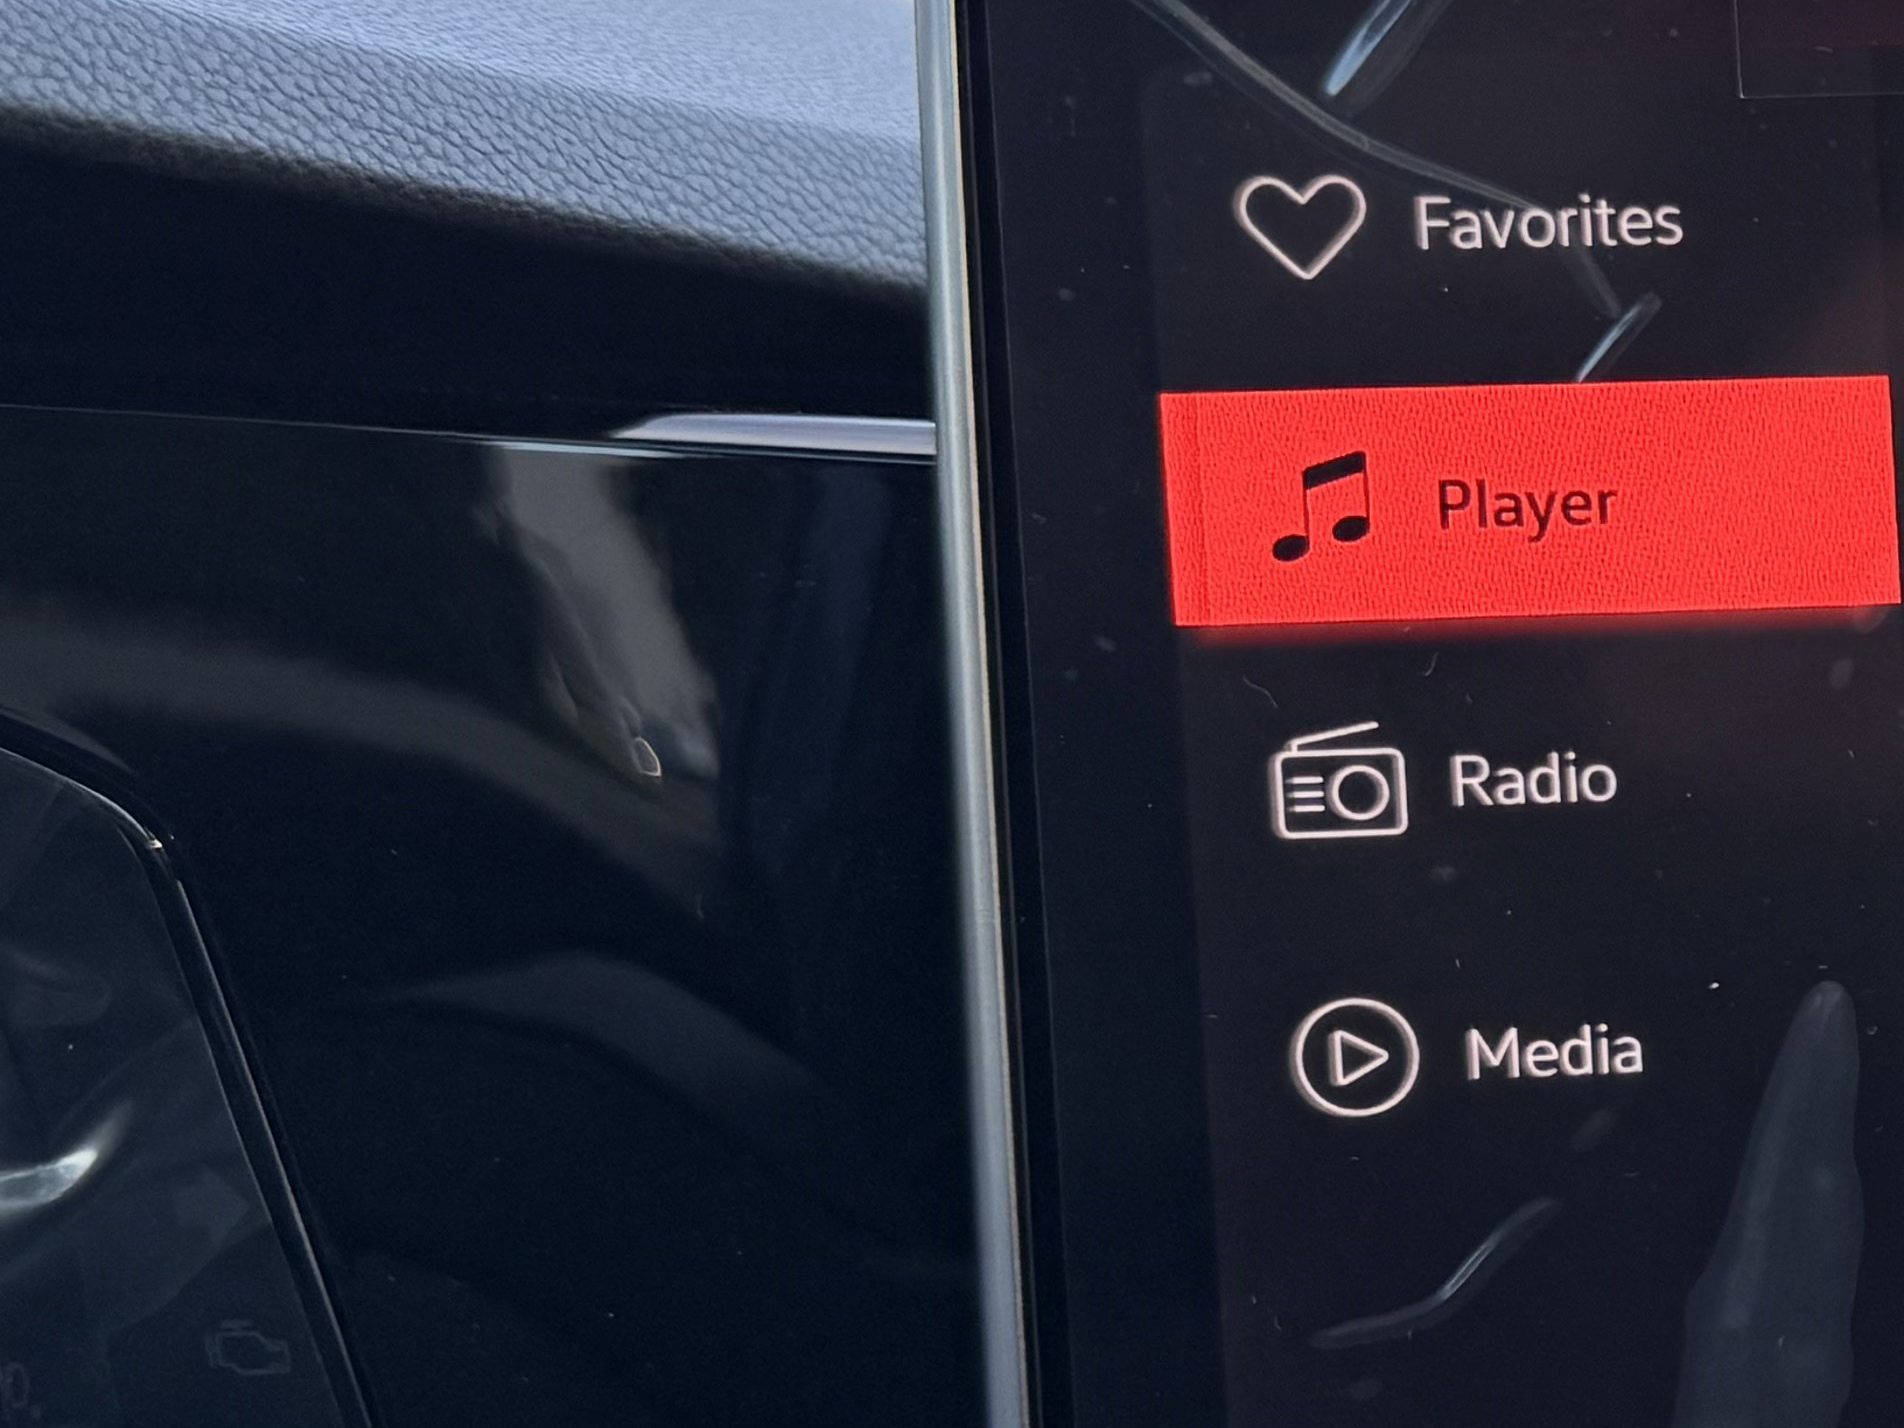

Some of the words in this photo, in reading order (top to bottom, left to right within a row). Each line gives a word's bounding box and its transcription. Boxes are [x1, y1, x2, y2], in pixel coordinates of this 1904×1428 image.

[1418, 191, 1683, 249] Favorites
[1439, 478, 1618, 541] Player
[1453, 749, 1616, 806] Radio
[1469, 1020, 1642, 1079] Media
